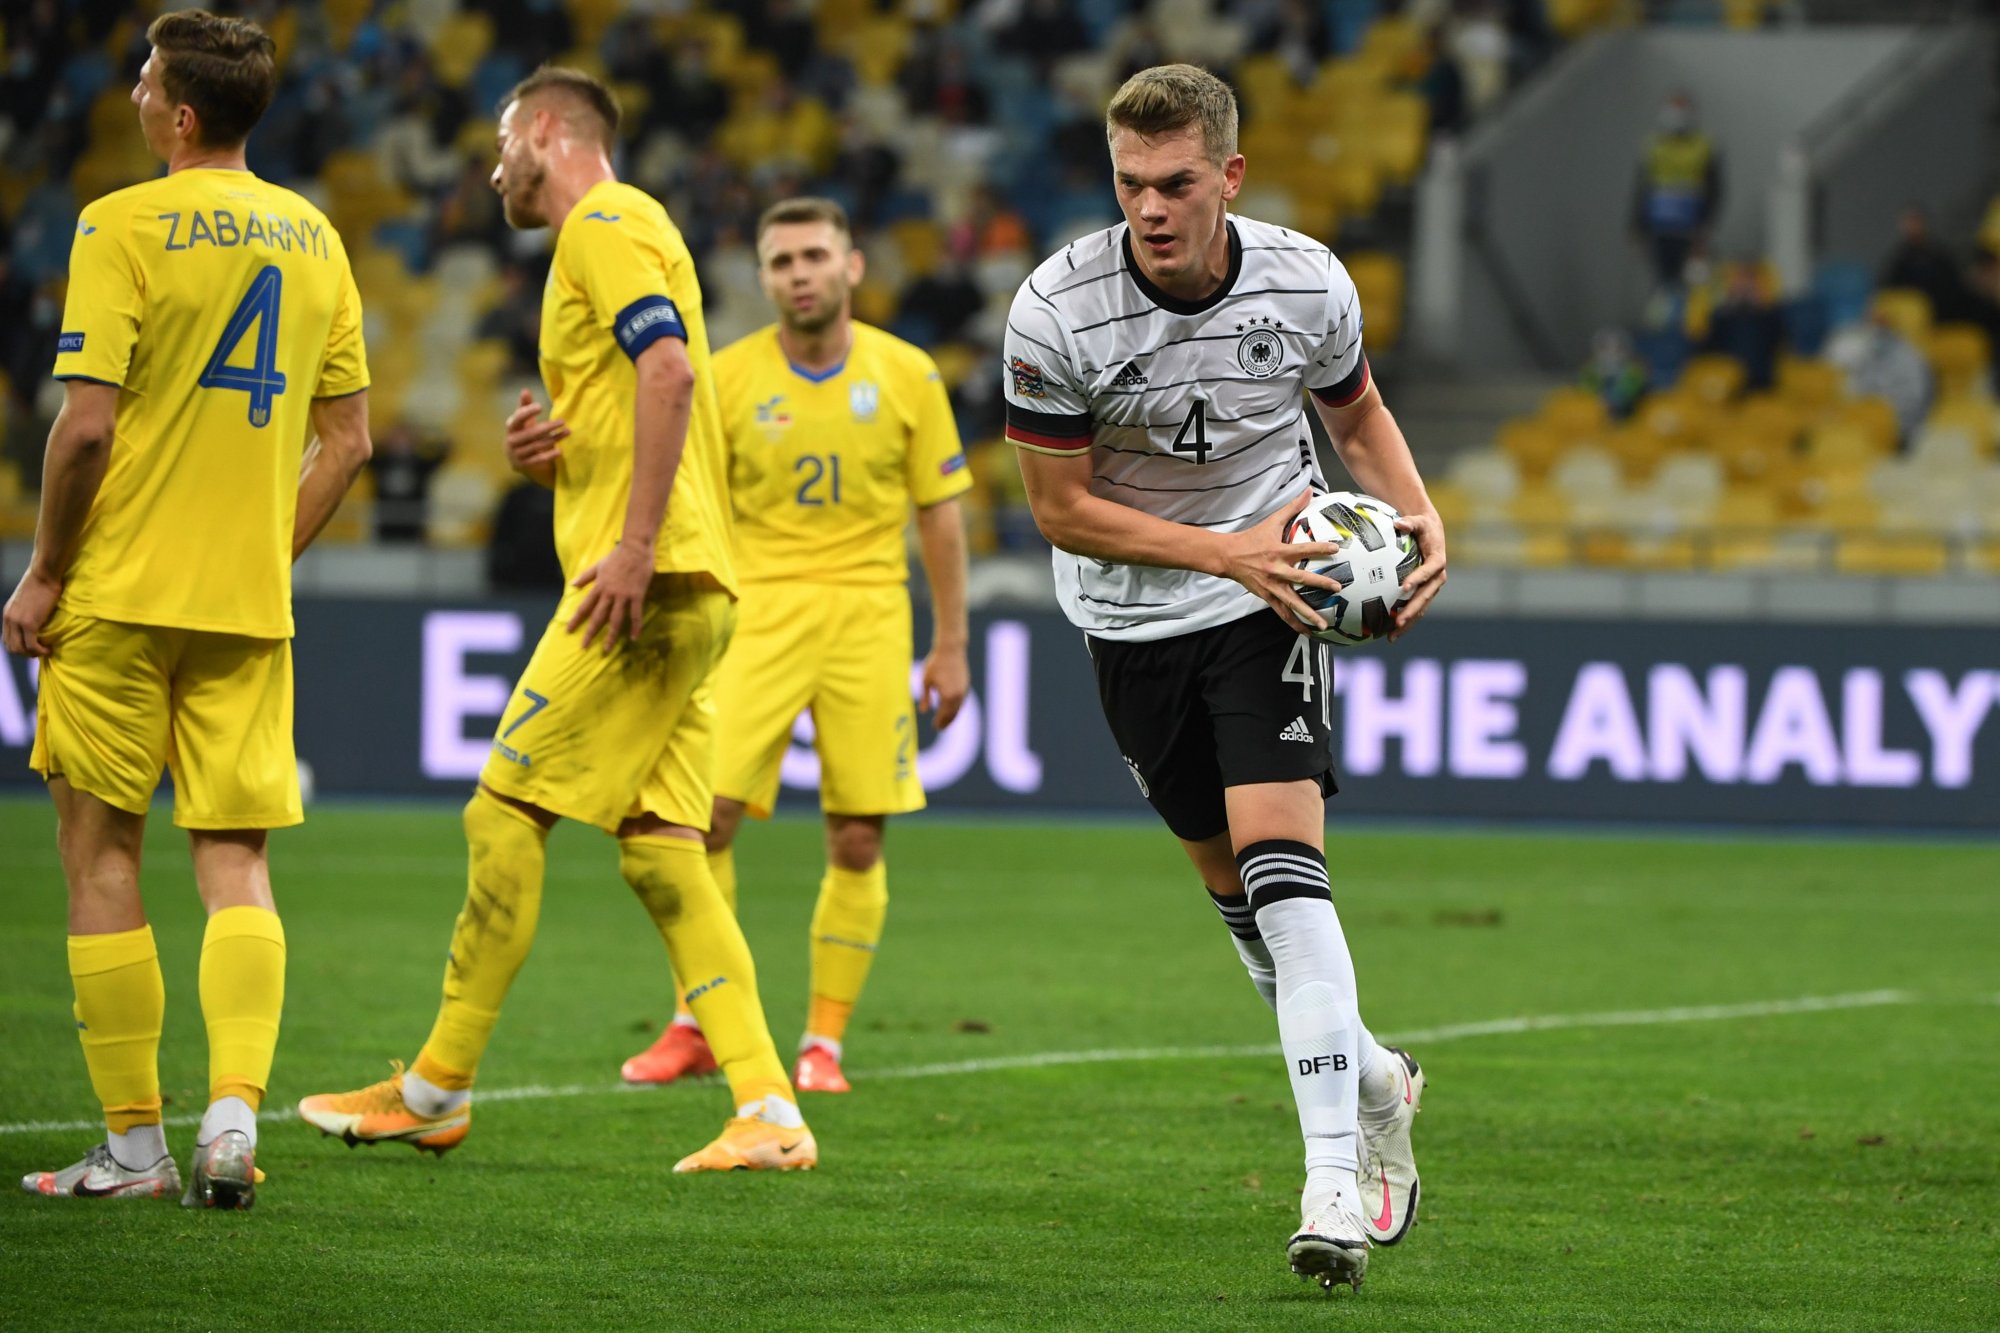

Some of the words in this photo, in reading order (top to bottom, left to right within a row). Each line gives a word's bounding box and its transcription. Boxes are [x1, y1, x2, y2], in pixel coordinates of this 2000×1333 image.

[158, 210, 329, 260] ZABARNYI
[198, 265, 287, 428] 4
[1110, 376, 1149, 386] adidas
[1172, 398, 1214, 466] 4
[794, 454, 842, 506] 21
[1281, 633, 1315, 702] 4
[503, 688, 550, 740] 7
[1280, 732, 1314, 743] adidas
[1298, 1053, 1348, 1076] DFB
